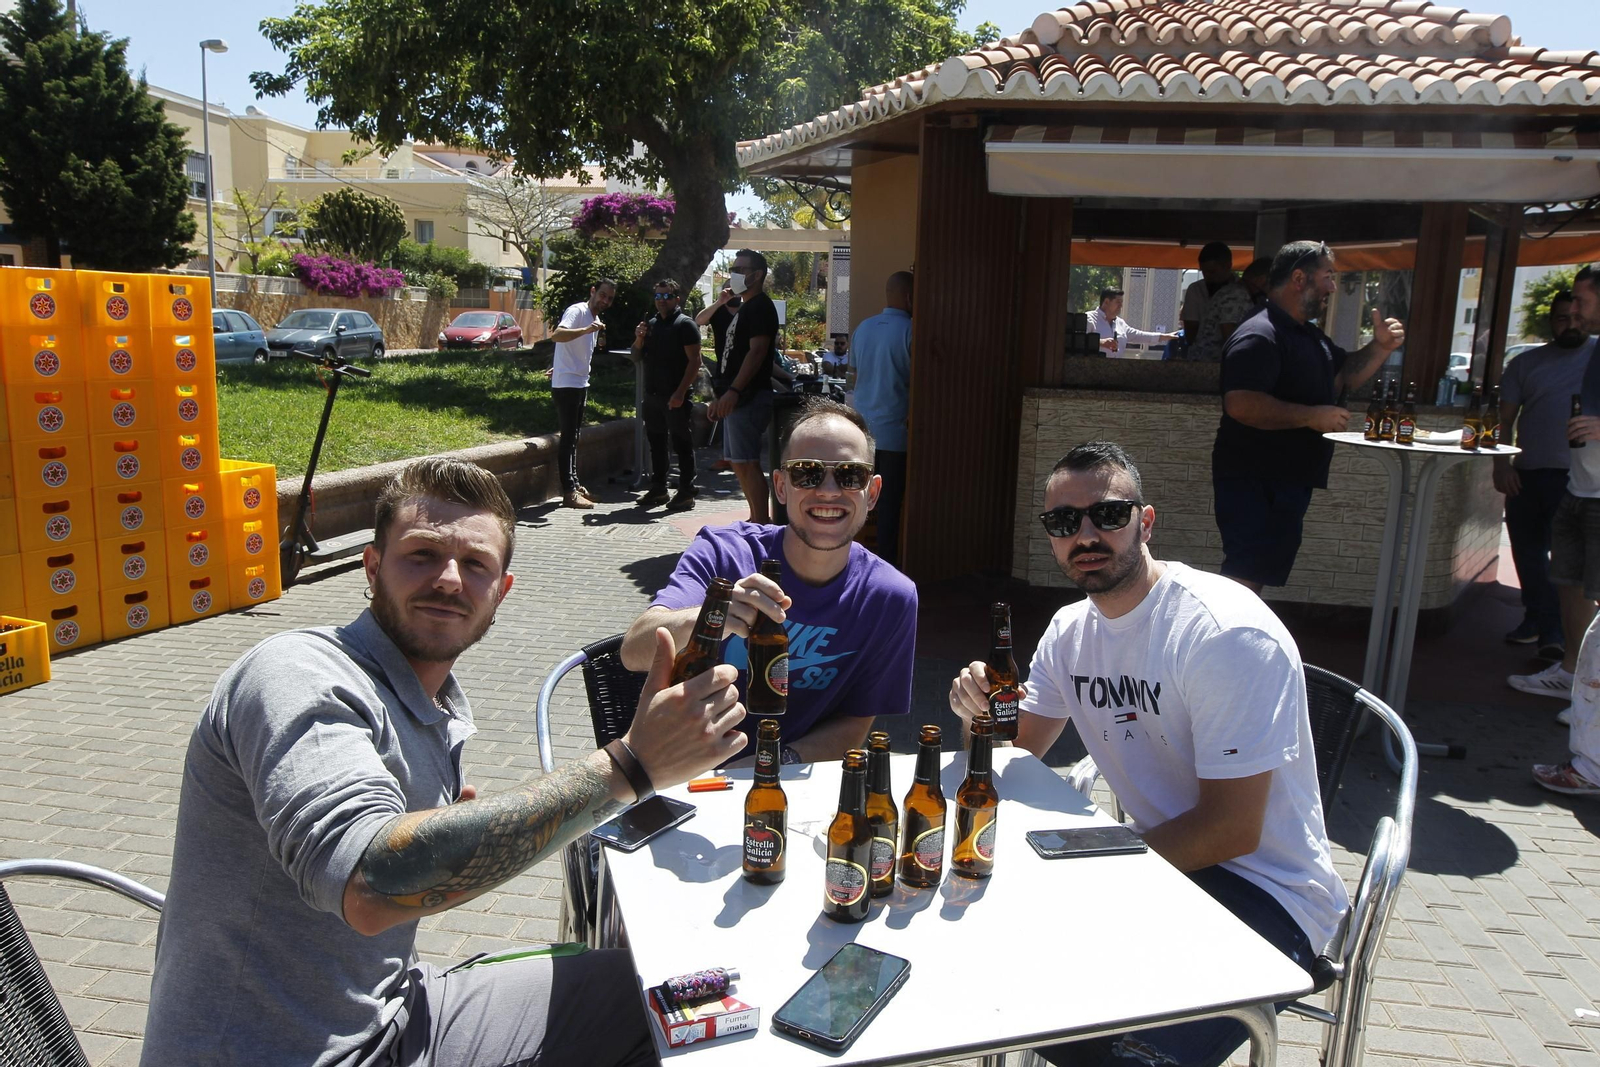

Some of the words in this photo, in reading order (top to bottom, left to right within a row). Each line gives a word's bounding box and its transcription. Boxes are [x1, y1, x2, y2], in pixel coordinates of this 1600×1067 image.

[793, 666, 838, 690] SB
[994, 701, 1017, 709] Estrella
[995, 708, 1017, 716] Galicia
[745, 836, 774, 848] Estrella
[746, 845, 772, 856] Galicia
[725, 1015, 750, 1023] Fumar
[726, 1023, 747, 1032] mata
